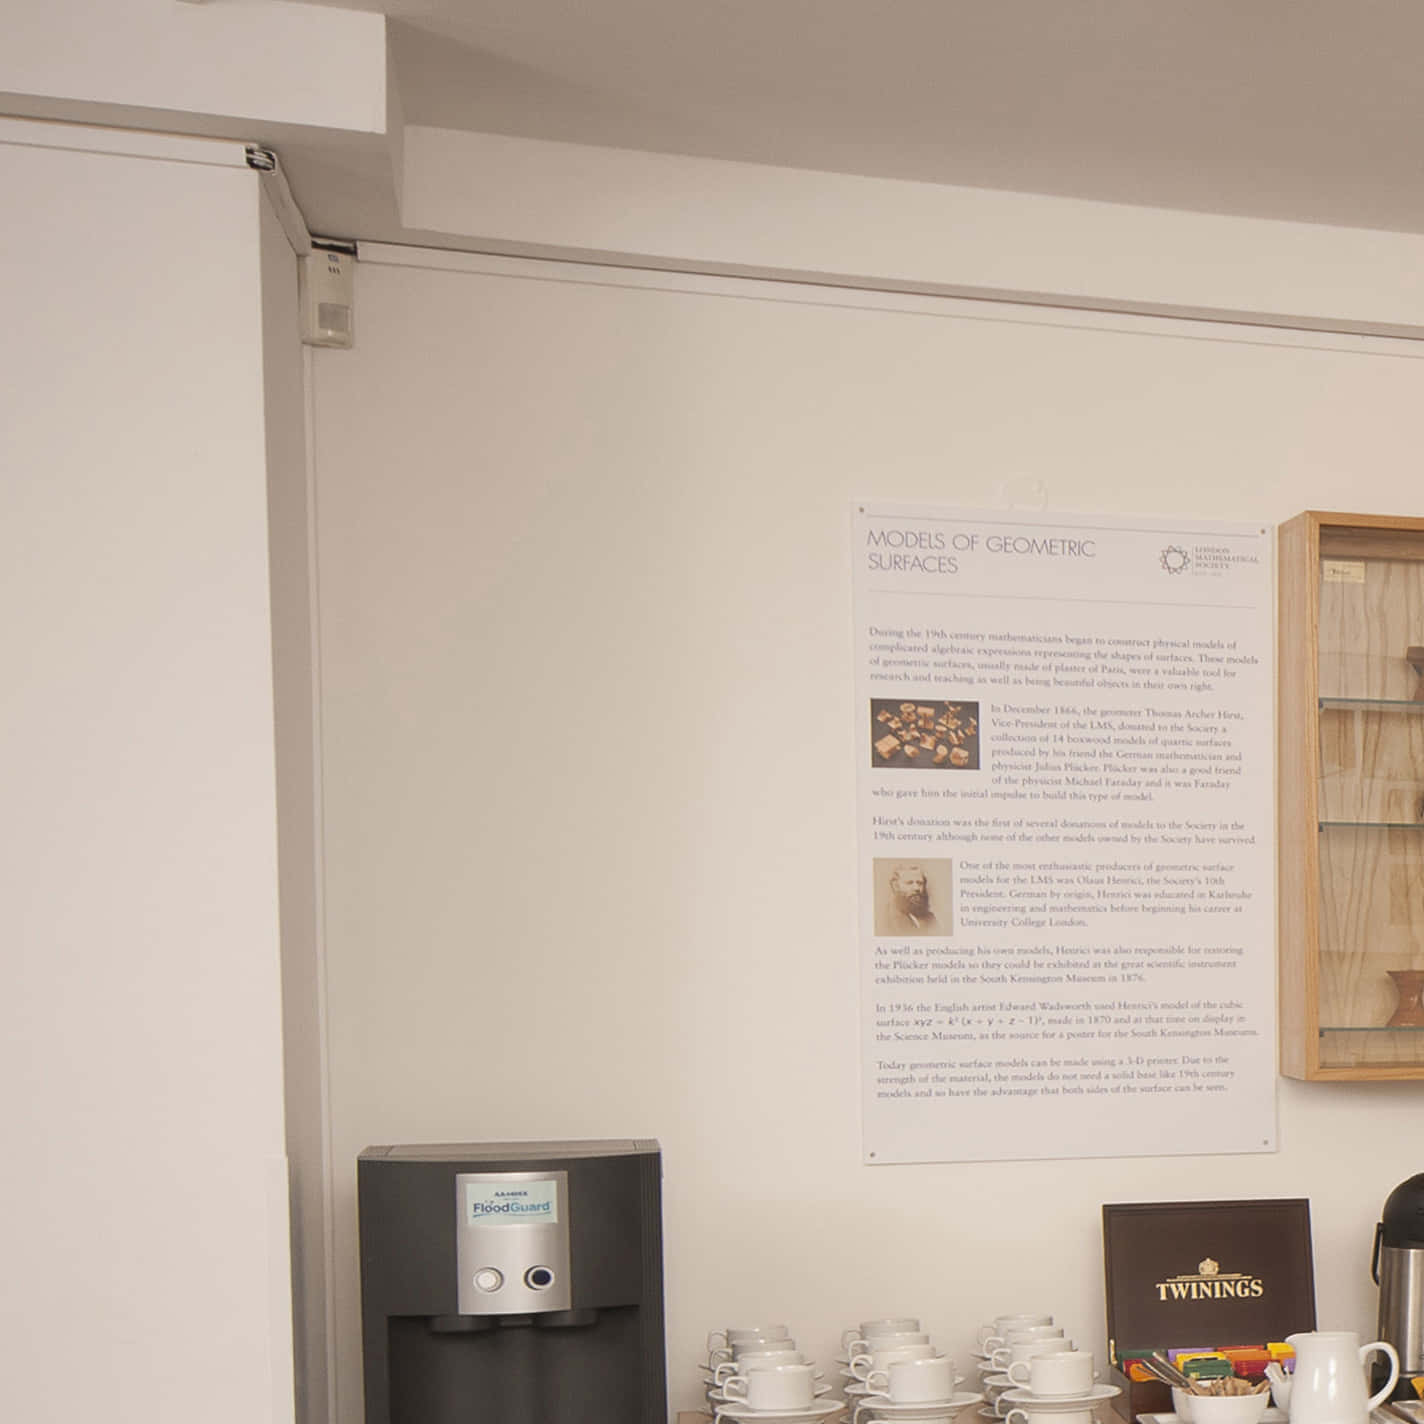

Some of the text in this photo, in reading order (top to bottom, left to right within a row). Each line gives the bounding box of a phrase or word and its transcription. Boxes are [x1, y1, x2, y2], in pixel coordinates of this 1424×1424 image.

[867, 529, 1097, 559] MODELS OF GEOMETRIC
[868, 553, 959, 576] SURFACES
[906, 628, 922, 638] the
[1095, 636, 1105, 644] to
[1226, 640, 1235, 649] of
[1093, 649, 1108, 659] the
[1143, 651, 1153, 661] of
[869, 656, 880, 666] of
[1041, 662, 1052, 672] of
[1088, 664, 1098, 673] of
[912, 672, 931, 682] and
[1131, 679, 1140, 688] in
[1083, 706, 1097, 715] the
[1059, 719, 1069, 729] of
[1072, 720, 1087, 729] the
[1157, 723, 1167, 731] to
[1169, 722, 1184, 732] the
[1039, 733, 1049, 743] of
[1148, 736, 1158, 745] of
[1038, 747, 1049, 759] by
[1098, 748, 1113, 758] the
[1224, 751, 1241, 760] and
[942, 788, 957, 797] the
[1029, 791, 1039, 799] to
[1110, 791, 1120, 800] of
[950, 974, 959, 983] in
[962, 974, 977, 983] the
[1108, 973, 1117, 982] in
[916, 1002, 931, 1012] the
[1190, 999, 1200, 1008] of
[1202, 999, 1216, 1008] the
[473, 1201, 551, 1214] FloodGuard
[1155, 1279, 1264, 1301] TWININGS
